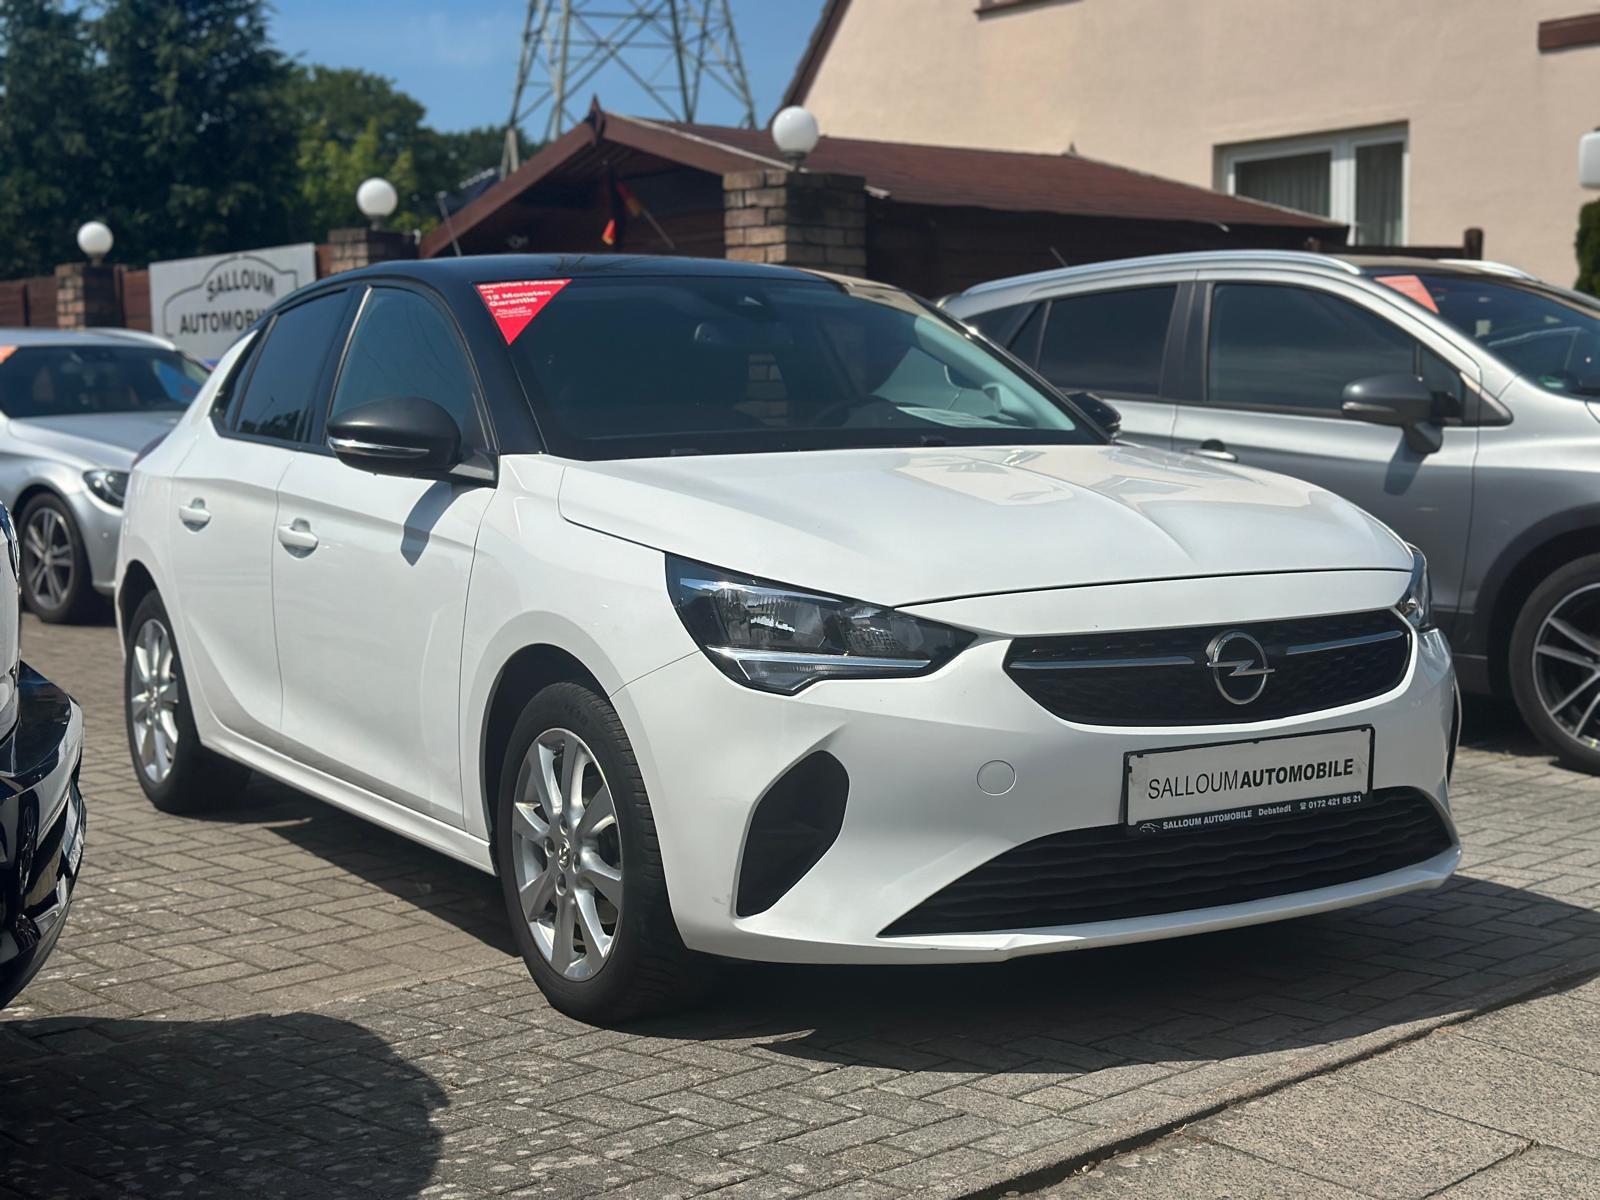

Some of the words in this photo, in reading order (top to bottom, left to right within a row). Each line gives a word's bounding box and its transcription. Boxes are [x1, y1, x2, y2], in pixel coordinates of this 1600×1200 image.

[207, 268, 276, 301] SALLOUM
[502, 290, 551, 299] Monaten
[489, 297, 537, 306] Garantie
[1162, 816, 1202, 830] SALLOUM
[1203, 810, 1253, 824] AUTOMOBILE
[1258, 804, 1292, 817] Debstedt
[1308, 799, 1326, 810] 0172
[1327, 797, 1341, 808] 421
[1352, 794, 1362, 804] 21
